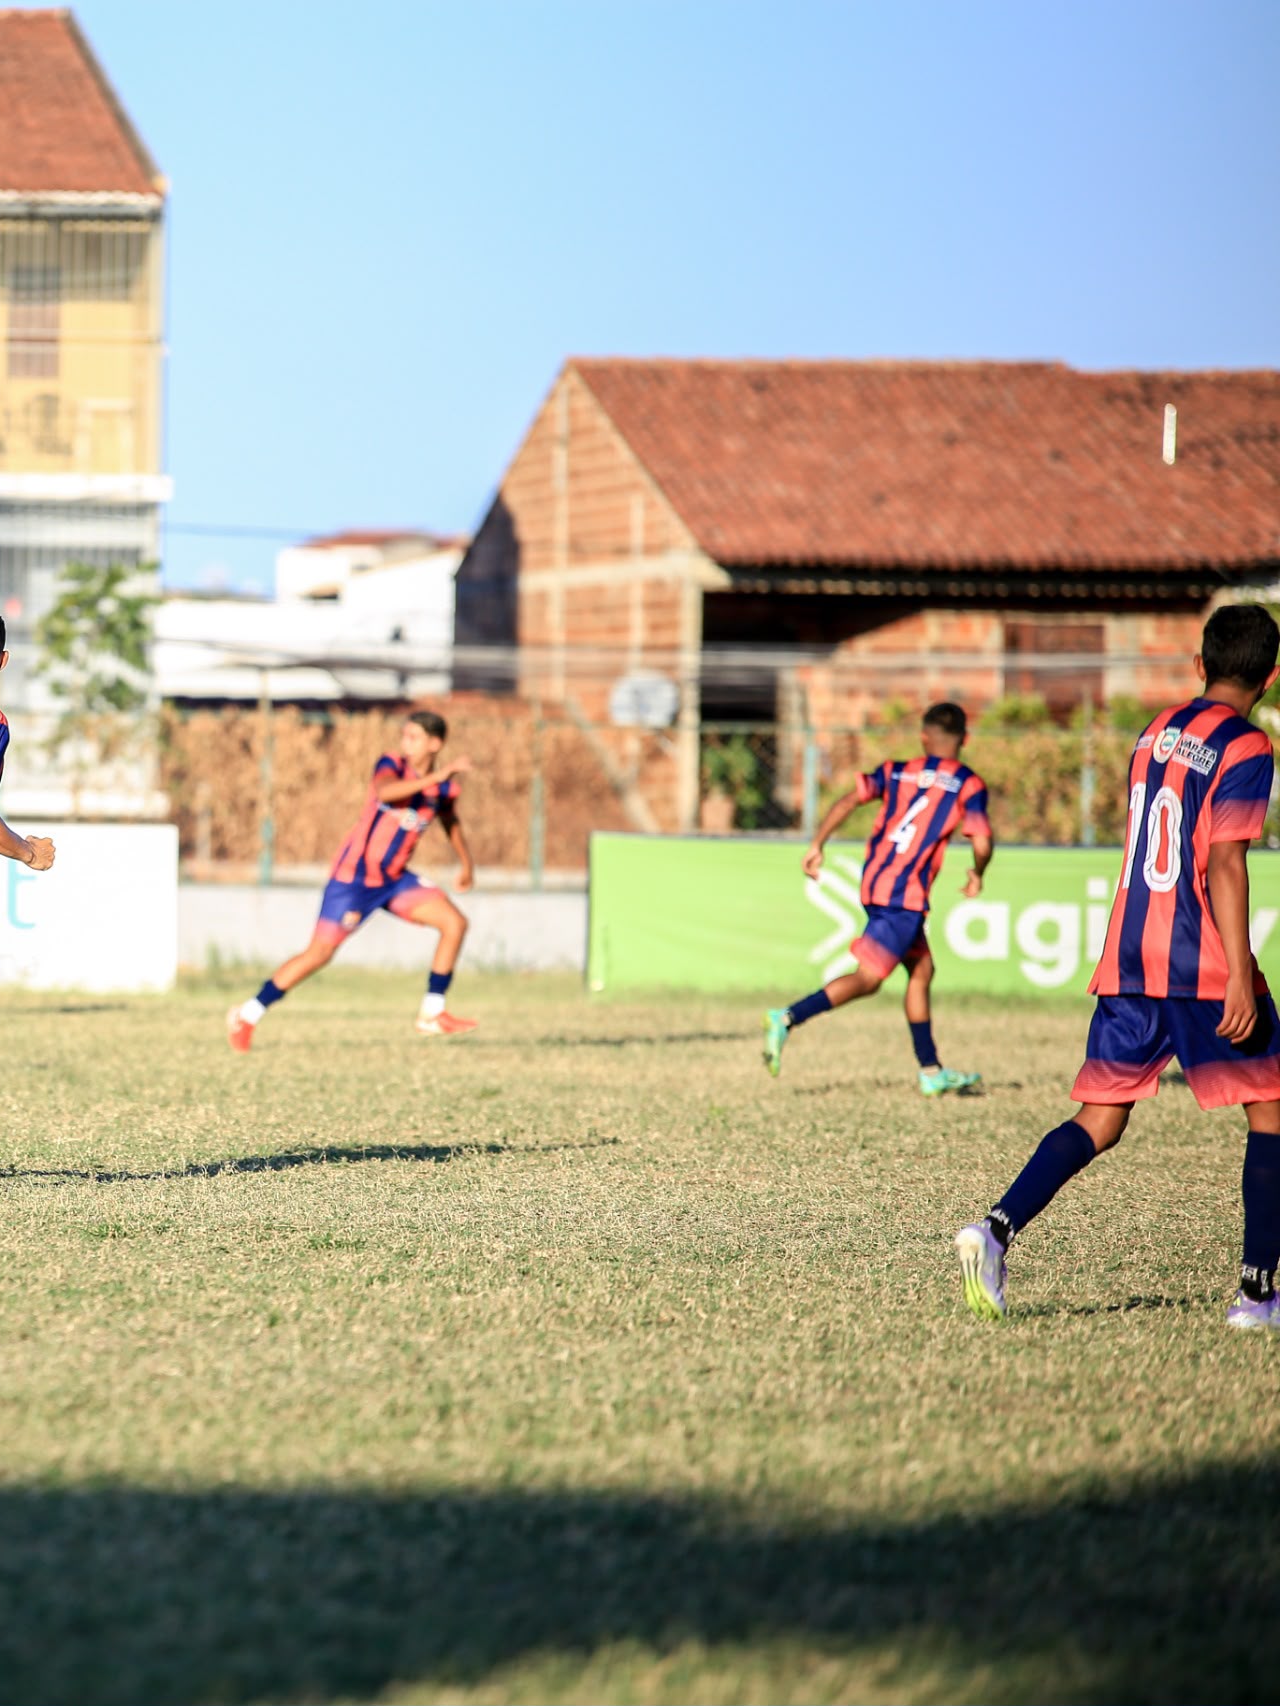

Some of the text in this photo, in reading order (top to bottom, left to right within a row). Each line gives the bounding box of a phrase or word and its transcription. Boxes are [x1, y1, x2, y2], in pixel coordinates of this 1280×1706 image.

[1175, 747, 1213, 769] ALEGRE
[888, 795, 929, 854] 4
[1122, 781, 1183, 893] 10
